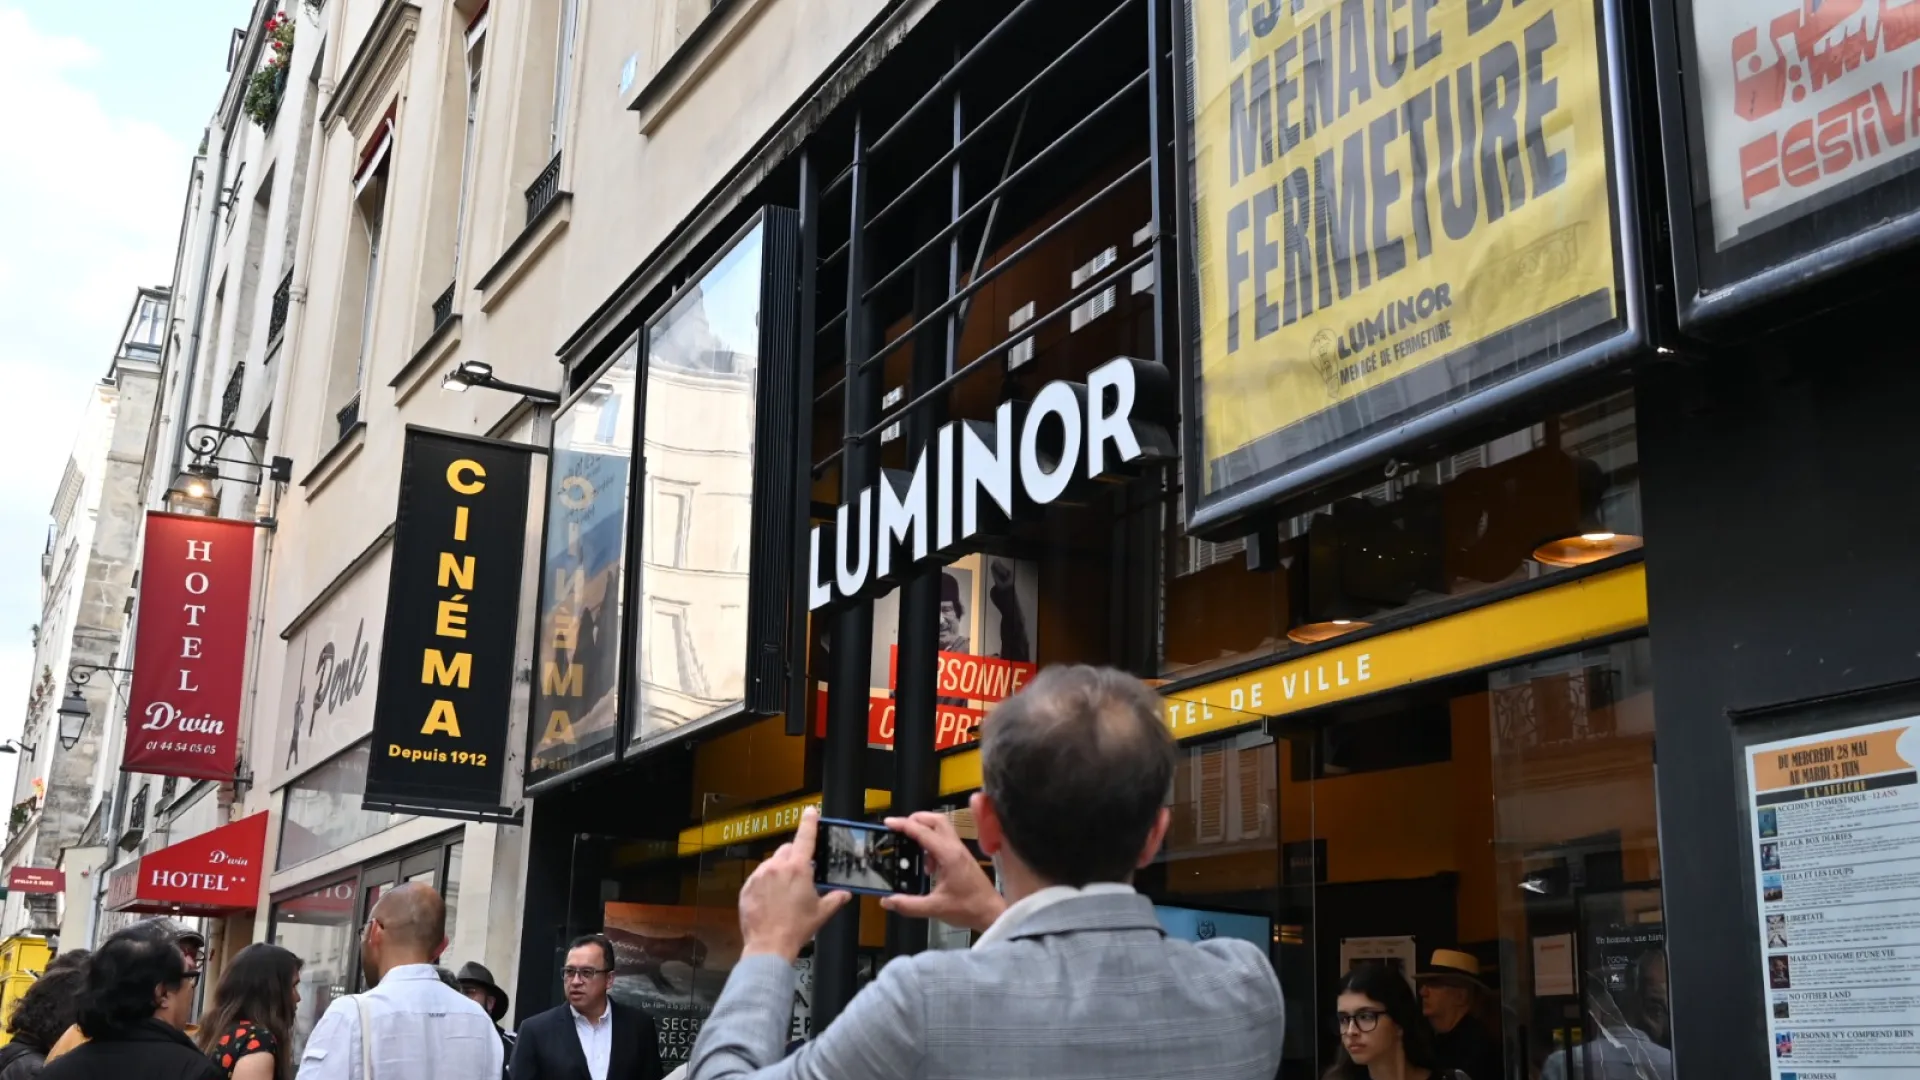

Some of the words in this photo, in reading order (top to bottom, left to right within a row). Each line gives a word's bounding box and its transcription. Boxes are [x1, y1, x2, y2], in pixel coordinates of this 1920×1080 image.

[1226, 8, 1567, 355] FERMETURE
[1338, 283, 1452, 360] LUMINOR
[1380, 347, 1392, 368] DE
[1393, 319, 1453, 361] FERMETURE
[808, 355, 1143, 612] LUMINOR
[420, 459, 487, 738] CINÉMA
[178, 539, 213, 692] HOTEL
[937, 655, 1027, 698] RSONNE
[1169, 696, 1213, 728] TEL
[1230, 682, 1263, 712] DE
[1281, 653, 1372, 700] VILLE
[141, 701, 225, 736] D'win
[145, 741, 158, 750] 01
[159, 741, 173, 752] 44
[388, 744, 448, 764] Depuis
[449, 750, 488, 767] 1912
[1791, 746, 1836, 768] MERCREDI
[1837, 744, 1849, 761] 28
[1850, 740, 1868, 758] MAI
[1801, 764, 1831, 784] MARDI
[1833, 764, 1840, 780] 3
[1777, 800, 1815, 813] ACCIDENT
[722, 814, 769, 840] CINÉMA
[208, 849, 249, 867] D'win
[151, 869, 230, 892] HOTEL
[1789, 993, 1800, 1001] NO
[1801, 992, 1828, 1000] OTHER
[1829, 990, 1851, 999] LAND
[662, 1017, 705, 1031] SECR
[1894, 1030, 1914, 1038] RIEN
